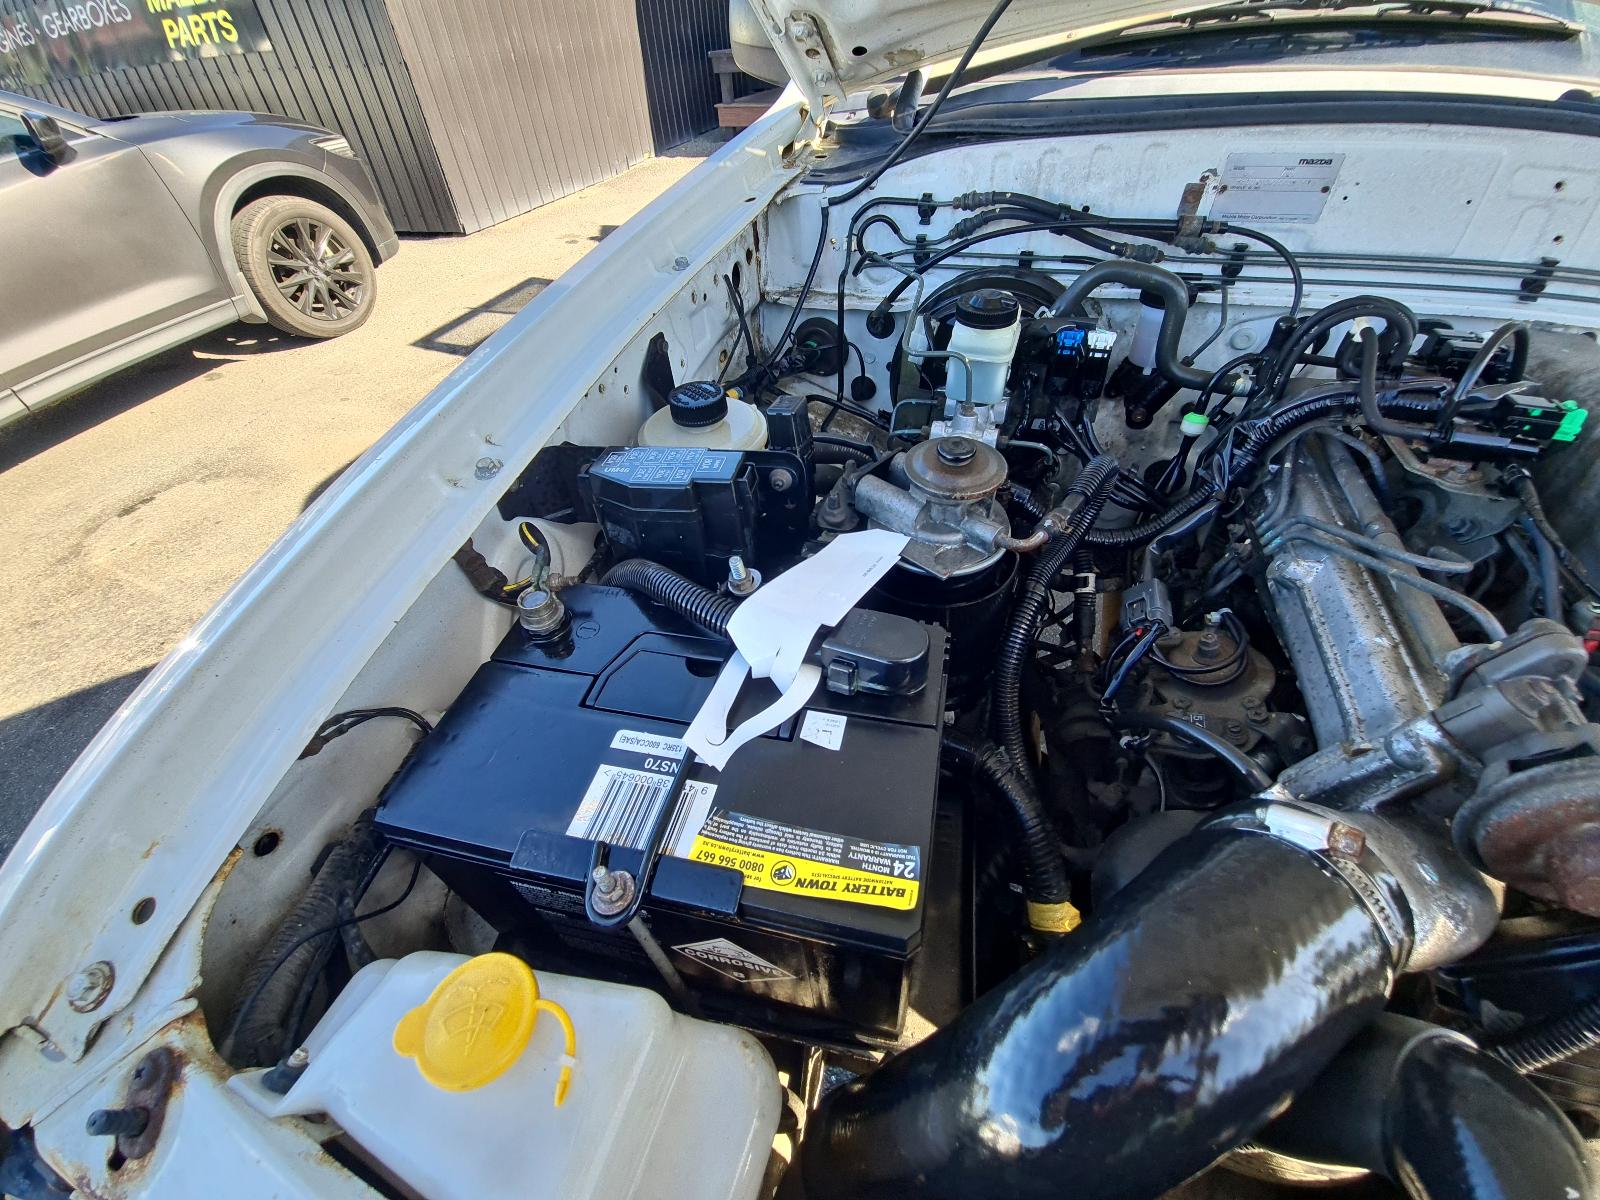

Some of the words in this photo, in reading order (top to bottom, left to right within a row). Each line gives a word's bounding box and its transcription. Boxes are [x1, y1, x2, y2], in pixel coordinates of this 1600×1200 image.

[42, 0, 132, 39] GEARBOXES
[162, 9, 239, 49] PARTS
[644, 757, 680, 774] NS70
[700, 786, 709, 795] 9
[696, 850, 716, 860] 667
[718, 855, 738, 867] 566
[848, 851, 891, 866] WARRANTY
[739, 859, 764, 873] 0800
[862, 862, 890, 874] MONTH
[893, 860, 916, 879] 24
[794, 877, 837, 892] TOWN
[841, 882, 906, 898] BATTERY
[684, 948, 782, 977] CORROSIVE
